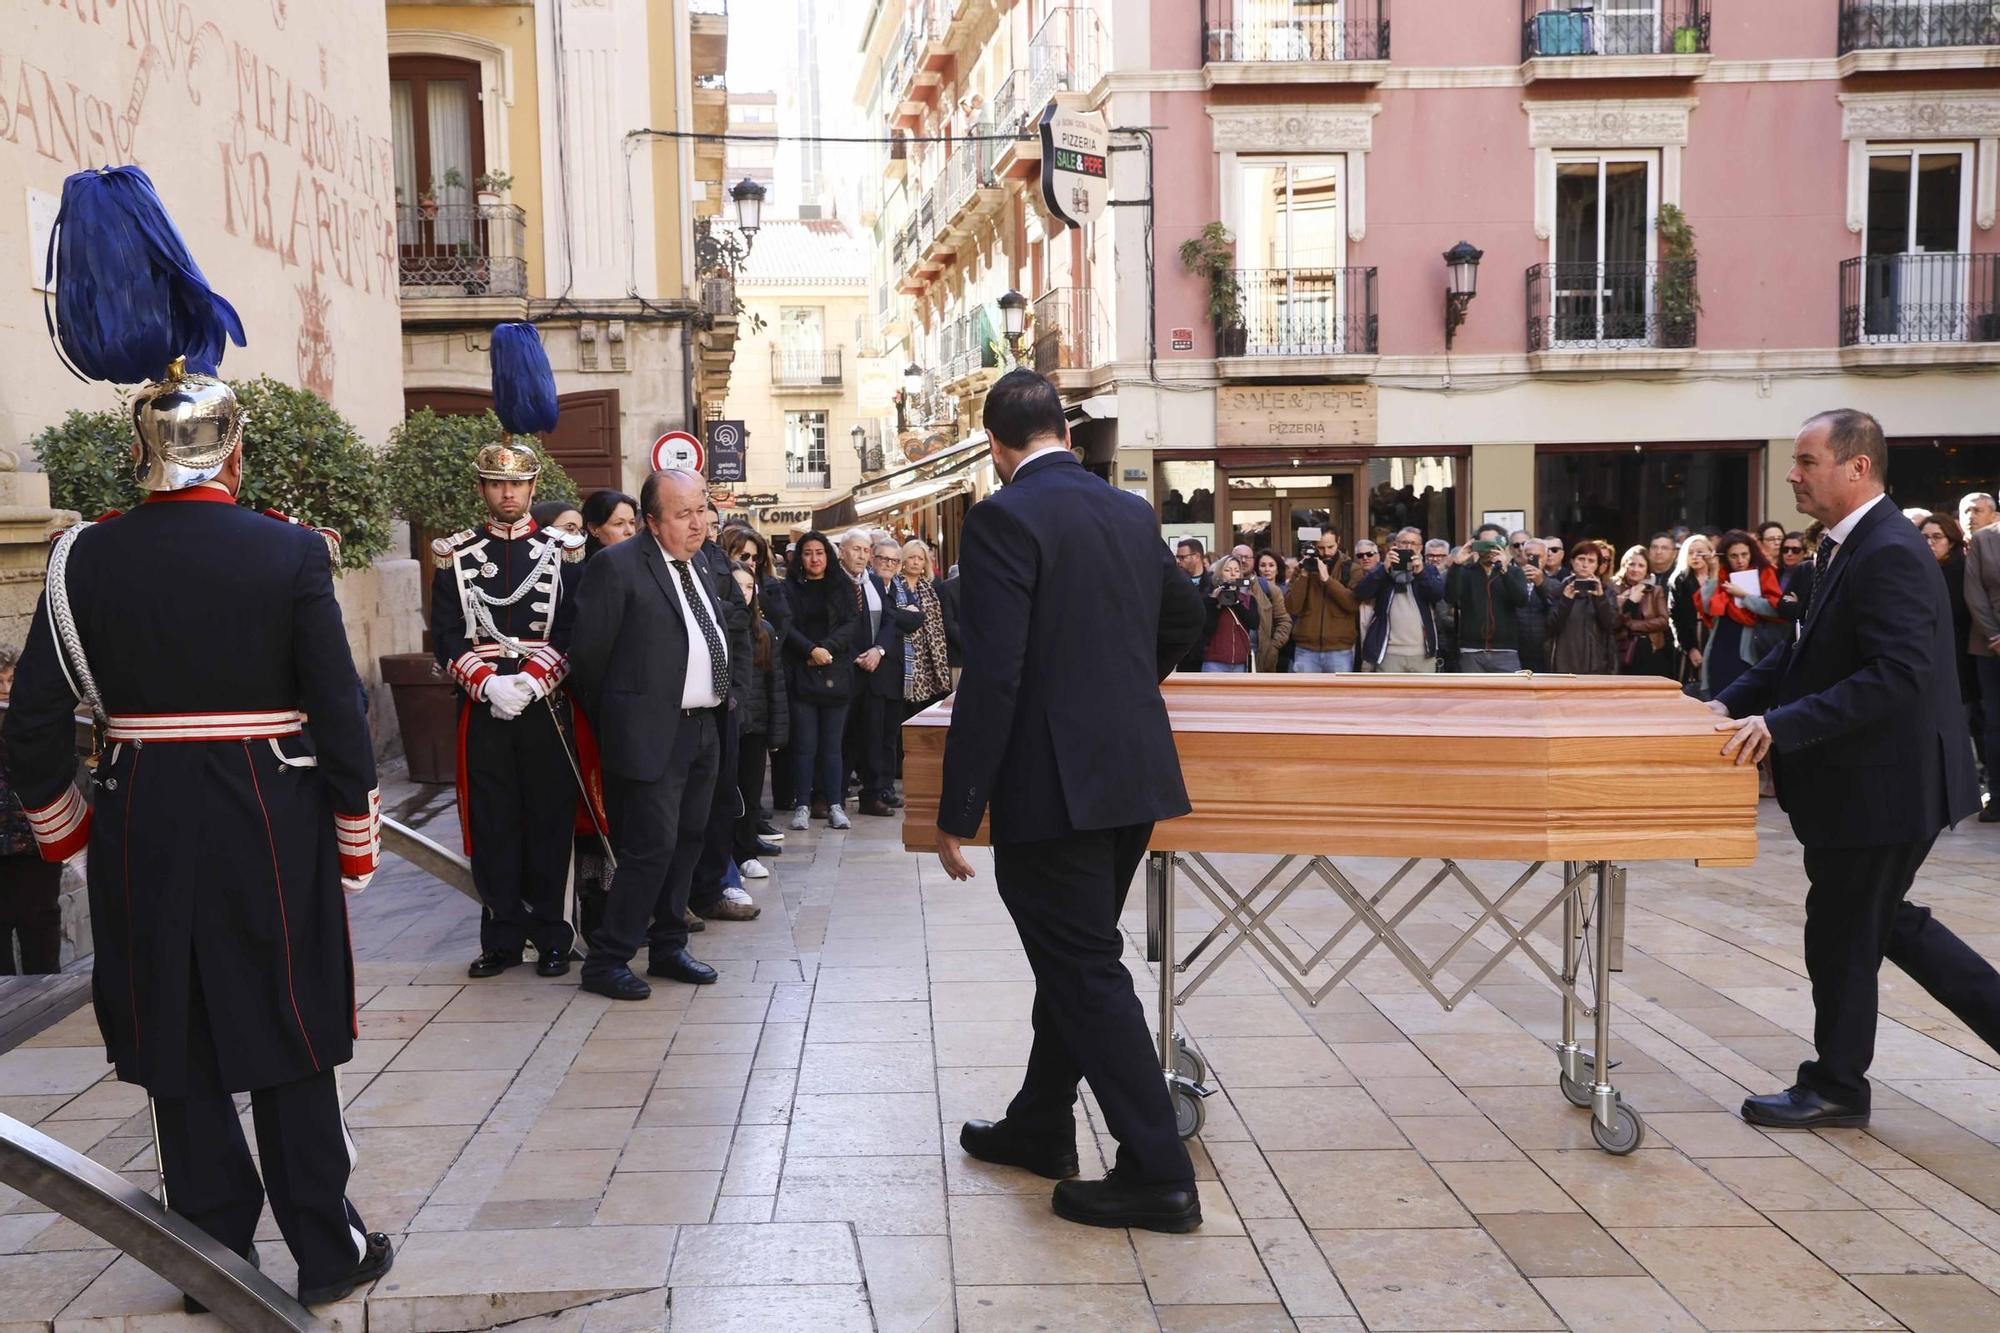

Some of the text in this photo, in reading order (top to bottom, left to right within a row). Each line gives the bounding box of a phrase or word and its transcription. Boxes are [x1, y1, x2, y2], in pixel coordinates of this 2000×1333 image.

[1062, 132, 1097, 151] PIZZERIA
[1232, 391, 1363, 409] SALE & PEPE
[1269, 423, 1325, 434] PIZZERIA
[759, 507, 811, 523] Comer
